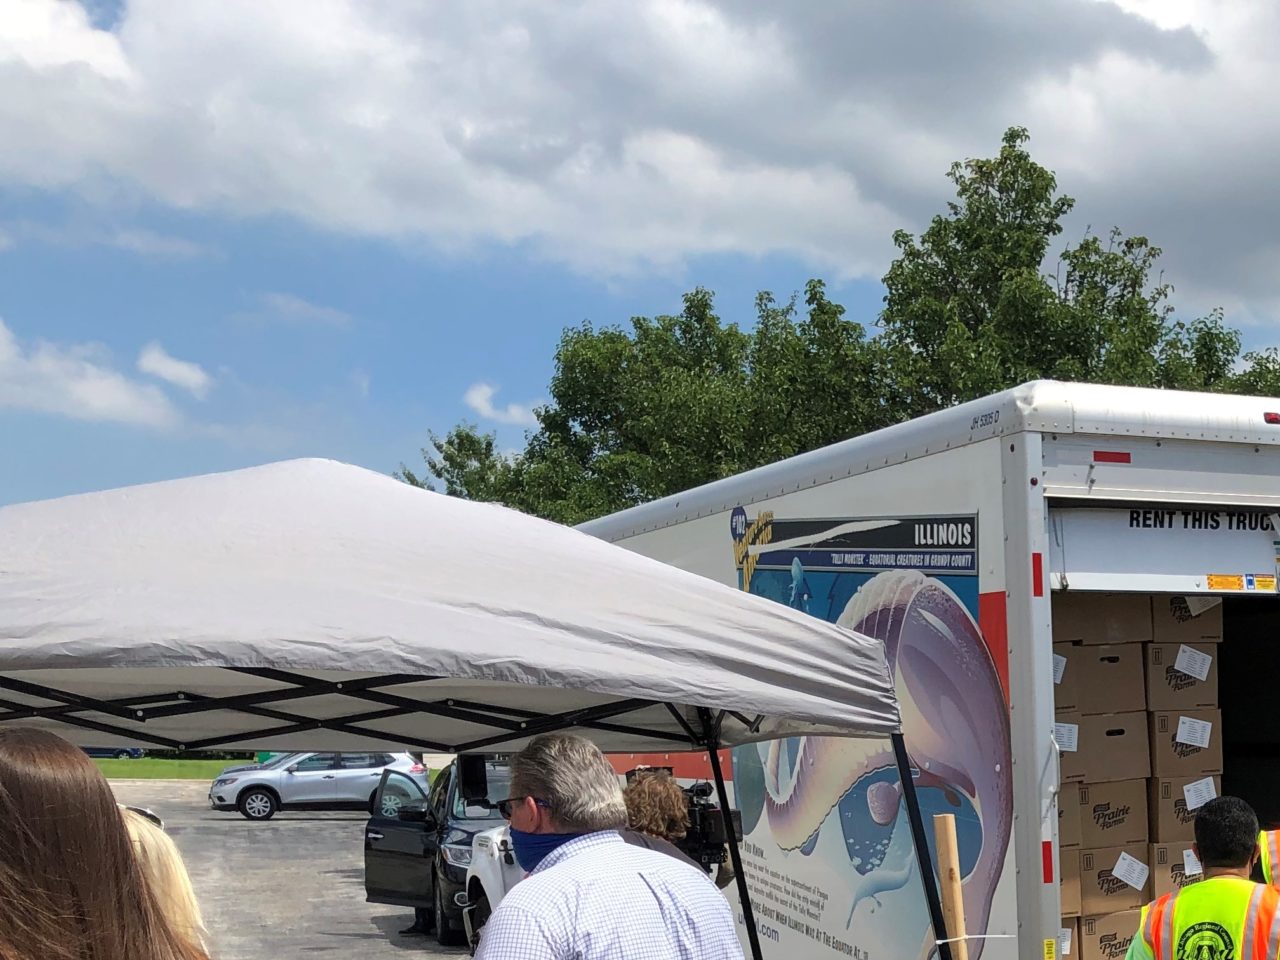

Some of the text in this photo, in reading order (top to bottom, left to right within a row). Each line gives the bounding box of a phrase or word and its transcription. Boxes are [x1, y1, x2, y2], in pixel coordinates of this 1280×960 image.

[1129, 510, 1176, 528] RENT
[1182, 511, 1220, 530] THIS
[914, 523, 972, 545] ILLINOIS
[1093, 804, 1130, 824] Prairie
[1100, 817, 1126, 830] Farms
[738, 913, 780, 942] ul.com
